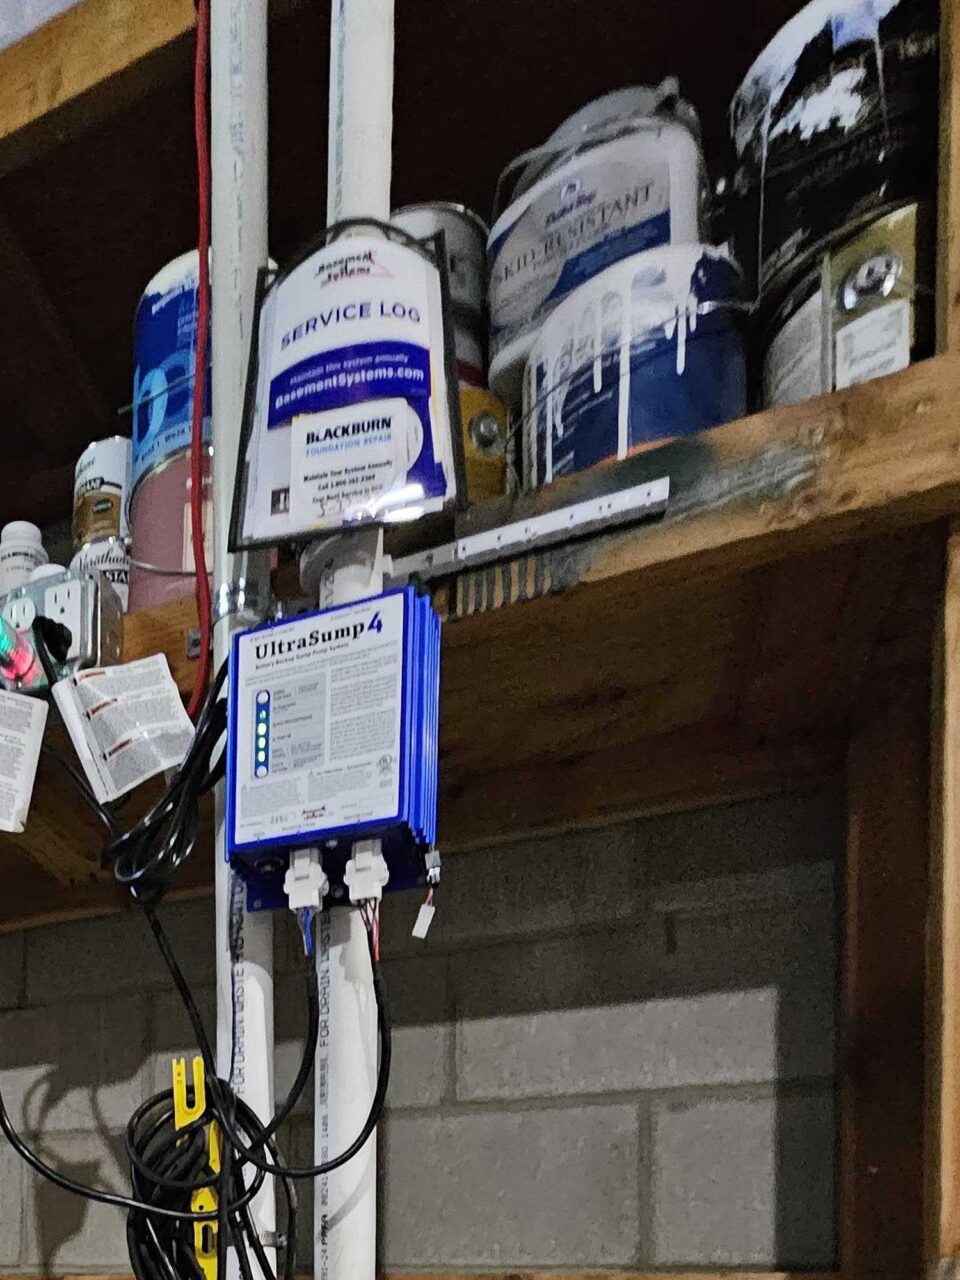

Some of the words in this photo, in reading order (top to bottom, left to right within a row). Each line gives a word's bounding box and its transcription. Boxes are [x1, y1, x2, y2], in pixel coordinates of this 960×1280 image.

[281, 302, 372, 350] SERVICE
[380, 301, 421, 324] LOG
[275, 366, 424, 410] BasementSystems.com
[306, 440, 361, 458] FOUNDATION
[255, 621, 366, 661] UltraSump
[367, 609, 384, 634] 4
[320, 969, 331, 1015] DRAIN
[320, 1019, 331, 1048] FOR
